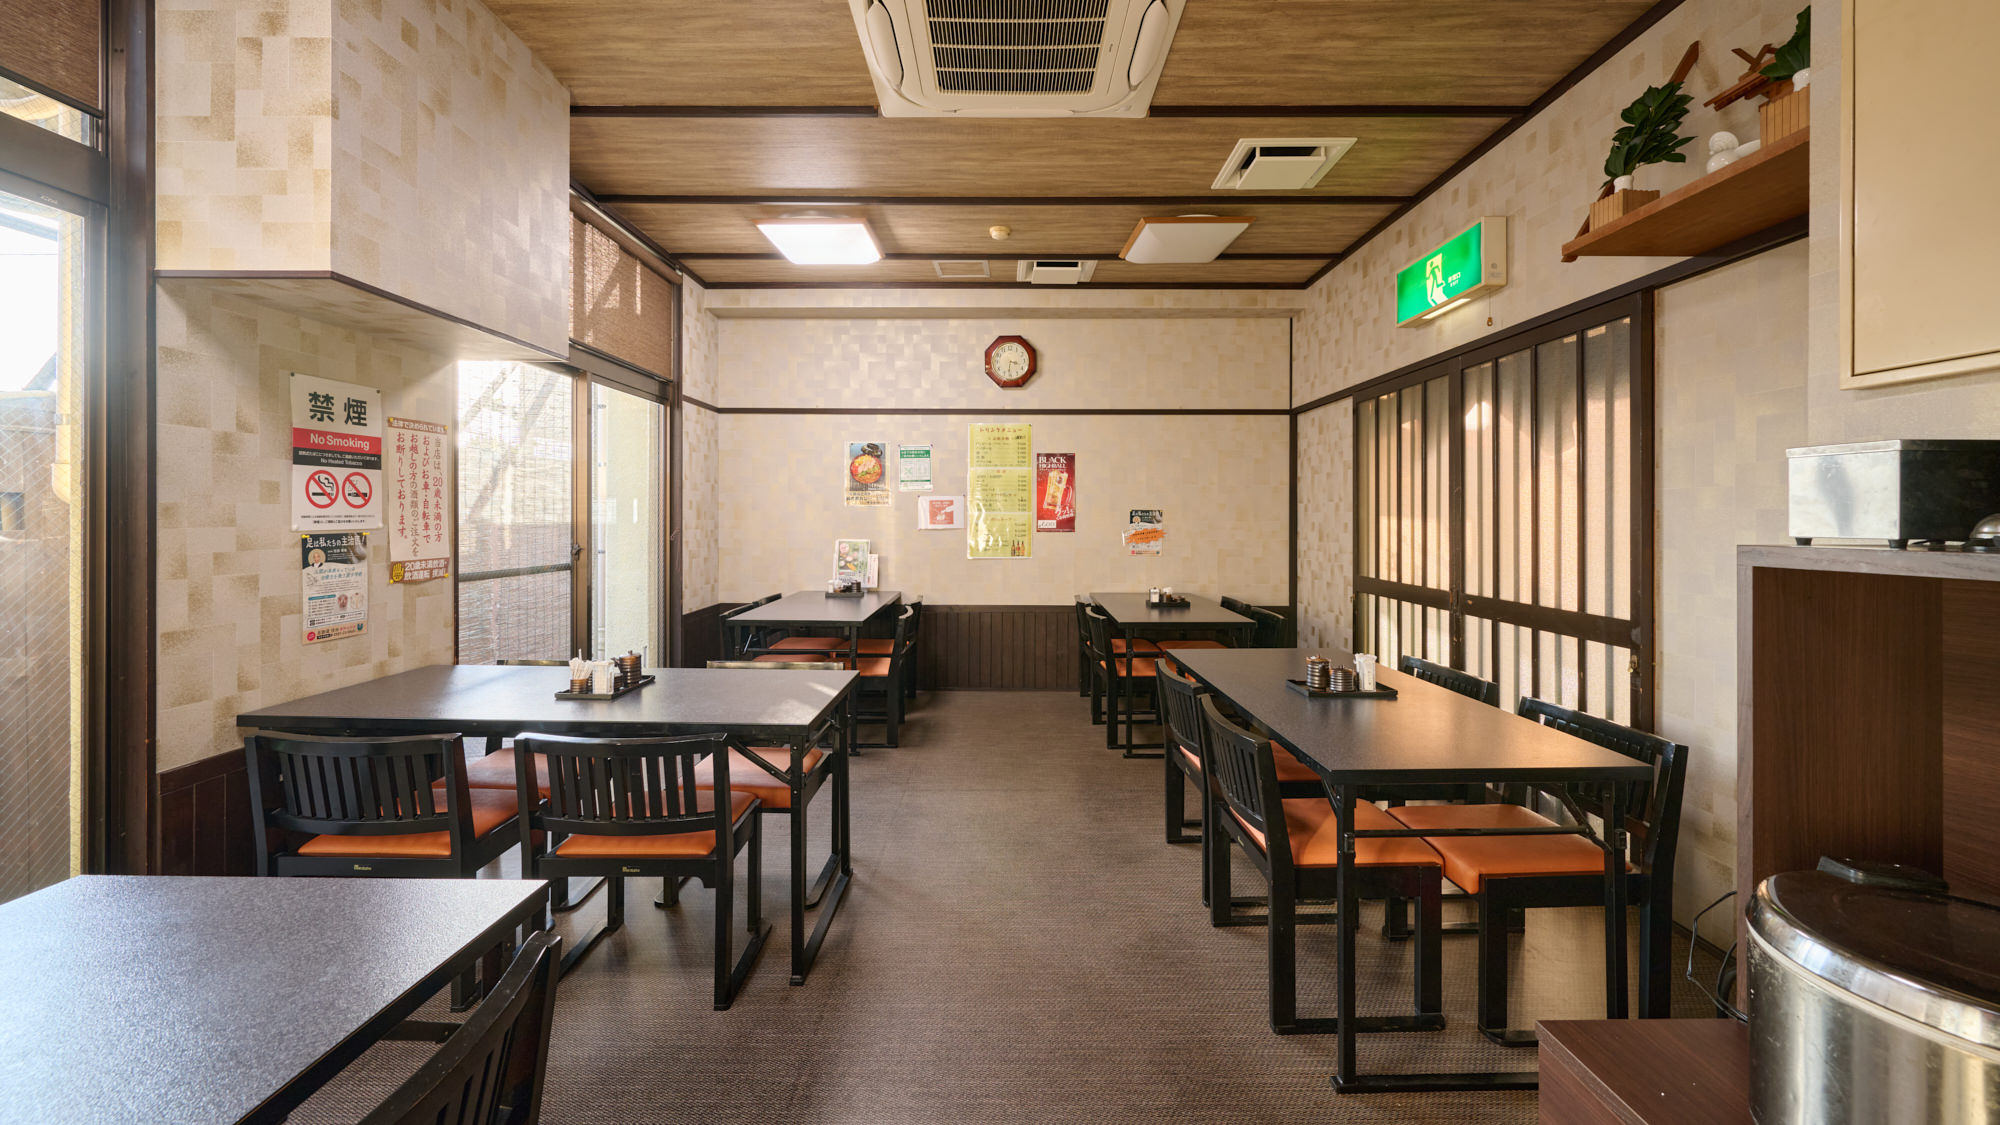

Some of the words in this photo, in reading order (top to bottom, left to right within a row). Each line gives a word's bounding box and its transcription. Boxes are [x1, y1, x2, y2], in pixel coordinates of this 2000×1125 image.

[308, 391, 368, 427] 禁煙
[310, 433, 325, 445] No
[326, 434, 370, 451] Smoking
[1039, 456, 1067, 464] BLACK
[396, 431, 408, 539] お断りしております。
[421, 435, 432, 544] およびお車・自転車で
